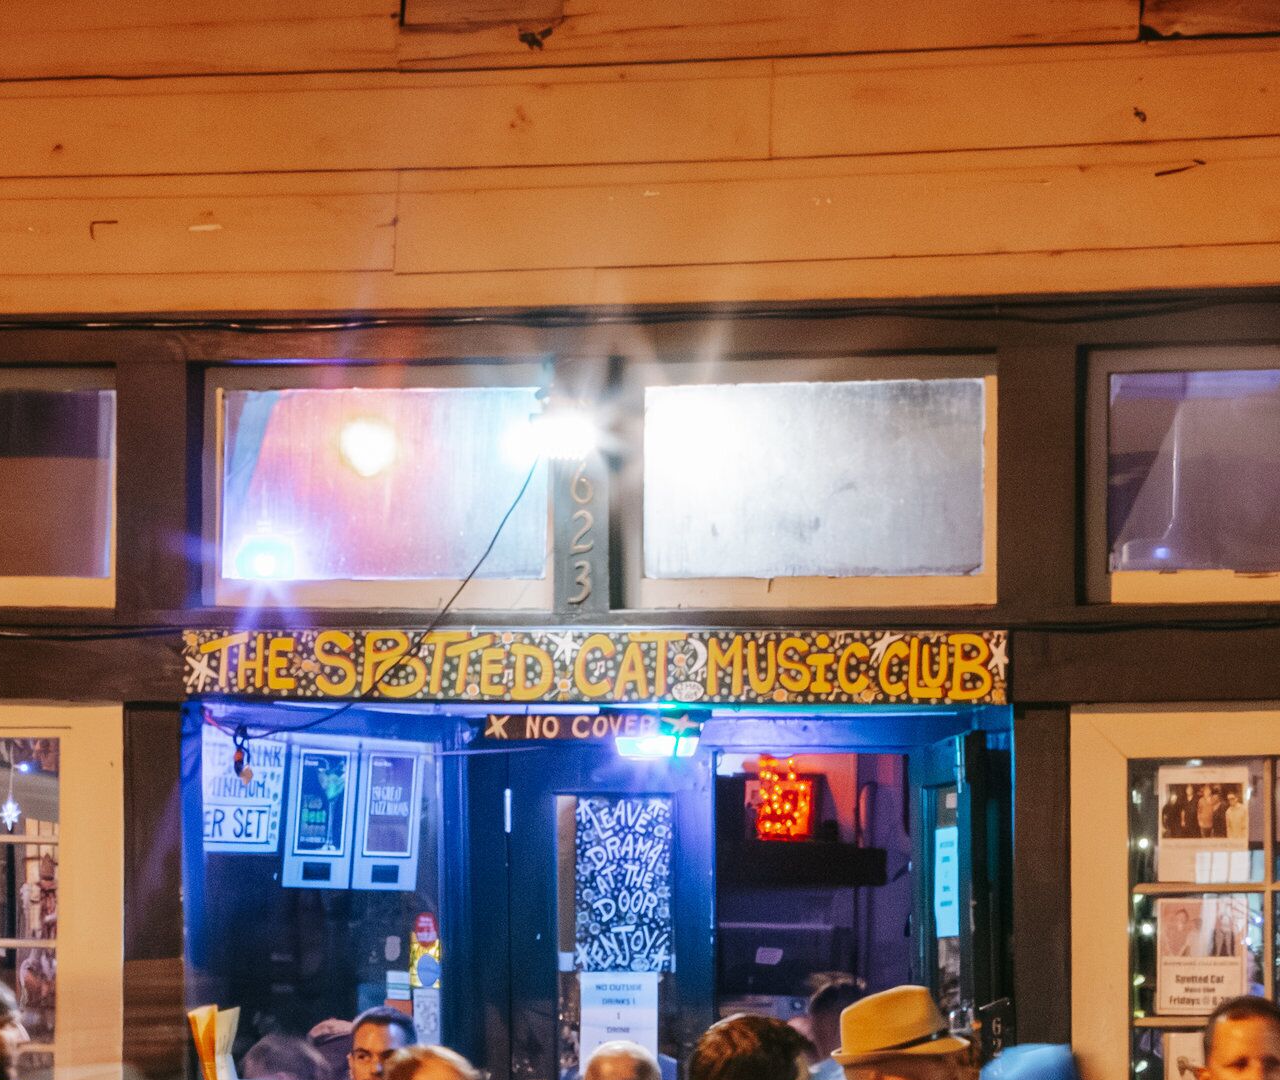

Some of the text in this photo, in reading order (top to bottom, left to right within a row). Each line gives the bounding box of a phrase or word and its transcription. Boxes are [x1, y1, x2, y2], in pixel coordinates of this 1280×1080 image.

[568, 461, 595, 606] 623
[199, 630, 993, 700] THE SPOTTED CAT MUSIC CLUB
[525, 713, 656, 739] NO COVER
[232, 807, 266, 841] SET
[590, 799, 652, 840] LEAVE
[584, 833, 664, 872] DRAMA
[595, 863, 655, 896] AT THE
[592, 889, 658, 923] DOOR
[595, 983, 608, 992] NO
